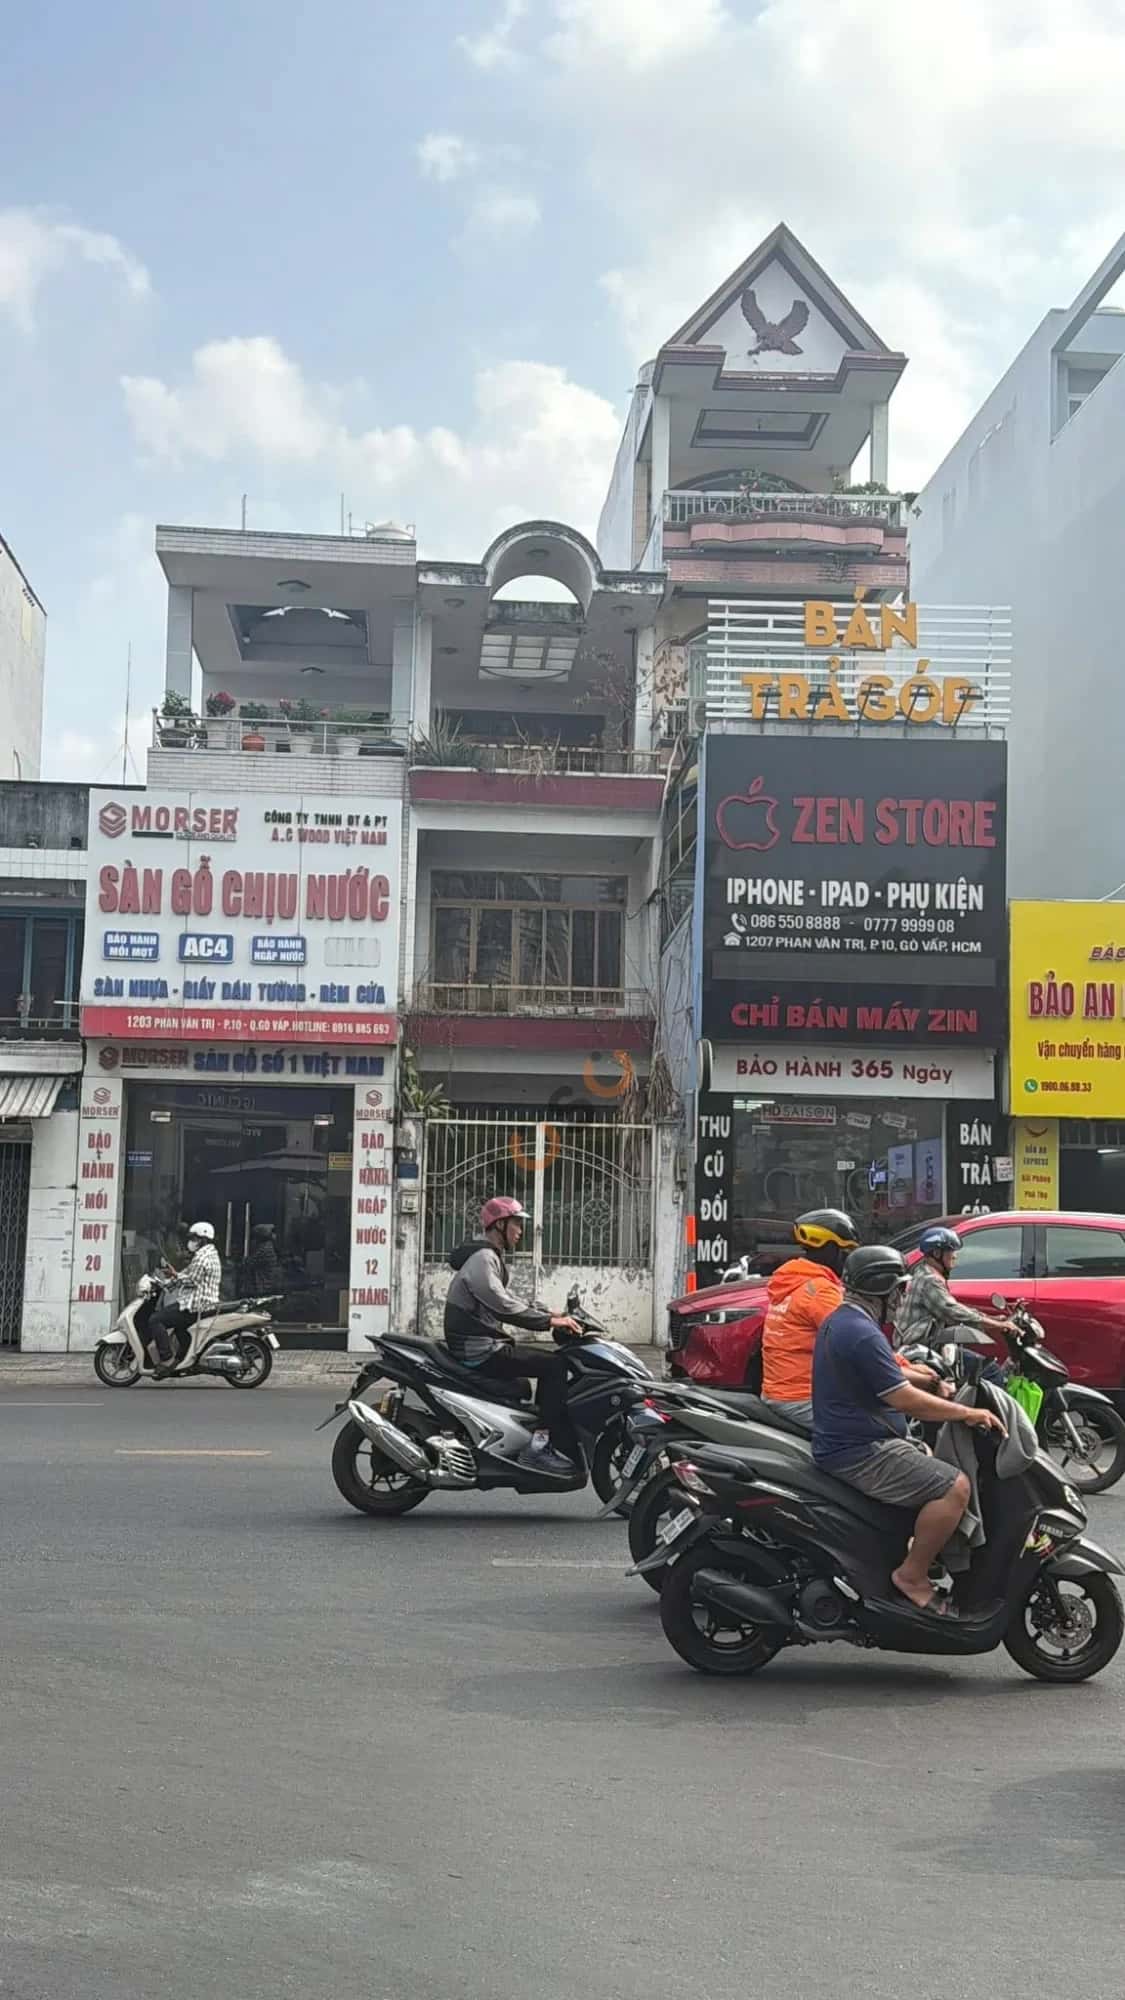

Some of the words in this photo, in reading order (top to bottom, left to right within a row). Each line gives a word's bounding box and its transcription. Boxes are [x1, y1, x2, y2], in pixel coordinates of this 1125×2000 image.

[804, 587, 917, 649] BÁN
[131, 804, 238, 833] MORSER
[296, 812, 309, 824] TY
[791, 797, 864, 845] ZEN
[875, 798, 997, 848] STORE
[298, 828, 330, 844] WOOD
[335, 827, 357, 847] VIỆT
[360, 831, 387, 845] NAM
[99, 859, 163, 915] SÀN
[171, 854, 213, 916] GỖ
[222, 869, 297, 925] CHỊU
[306, 865, 390, 922] NƯỚC
[727, 877, 804, 906] IPHONE
[821, 880, 869, 907] IPAD
[887, 882, 930, 917] PHỤ
[935, 876, 984, 918] KIỆN
[750, 913, 776, 928] 086
[778, 914, 804, 929] 550
[806, 915, 841, 930] 8888
[863, 917, 897, 932] 0777
[901, 917, 935, 932] 9999
[183, 937, 228, 958] AC4
[746, 935, 773, 947] 1207
[775, 936, 812, 948] PHAN
[952, 940, 982, 953] HCM
[94, 976, 123, 998] SÀN
[129, 977, 168, 1001] NHỰA
[357, 980, 385, 1005] CỬA
[1029, 971, 1074, 1017] BẢO
[1084, 982, 1115, 1018] AN
[127, 1016, 152, 1028] 1203
[731, 996, 780, 1027] CHỈ
[786, 998, 848, 1028] BÁN
[857, 1001, 920, 1032] MÁY
[928, 1009, 977, 1033] ZIN
[1037, 1040, 1056, 1060] Vận
[1058, 1037, 1094, 1060] chuyển
[1097, 1043, 1122, 1060] hàng
[194, 1048, 229, 1072] SÀN
[262, 1048, 284, 1073] SỐ
[288, 1054, 297, 1074] 1
[303, 1051, 342, 1078] VIỆT
[345, 1056, 385, 1076] NAM
[736, 1053, 777, 1075] BẢO
[786, 1056, 841, 1077] HÀNH
[851, 1059, 894, 1079] 365
[903, 1063, 952, 1084] Ngày
[82, 1106, 120, 1116] MORSER
[699, 1115, 731, 1138] THU
[960, 1117, 992, 1146] BÁN
[88, 1129, 111, 1149] BẢO
[361, 1129, 384, 1149] BẢO
[81, 1159, 114, 1179] HÀNH
[703, 1150, 724, 1177] CŨ
[961, 1154, 991, 1185] TRẢ
[85, 1188, 107, 1210] MỐI
[357, 1196, 387, 1216] NGẬP
[700, 1189, 727, 1222] ĐỔI
[82, 1223, 108, 1243] MỌT
[356, 1225, 386, 1245] NƯỚC
[697, 1234, 728, 1262] MỚI
[85, 1255, 101, 1272] 20
[365, 1259, 378, 1276] 12
[79, 1284, 105, 1302] NĂM
[352, 1285, 388, 1305] THÁNG
